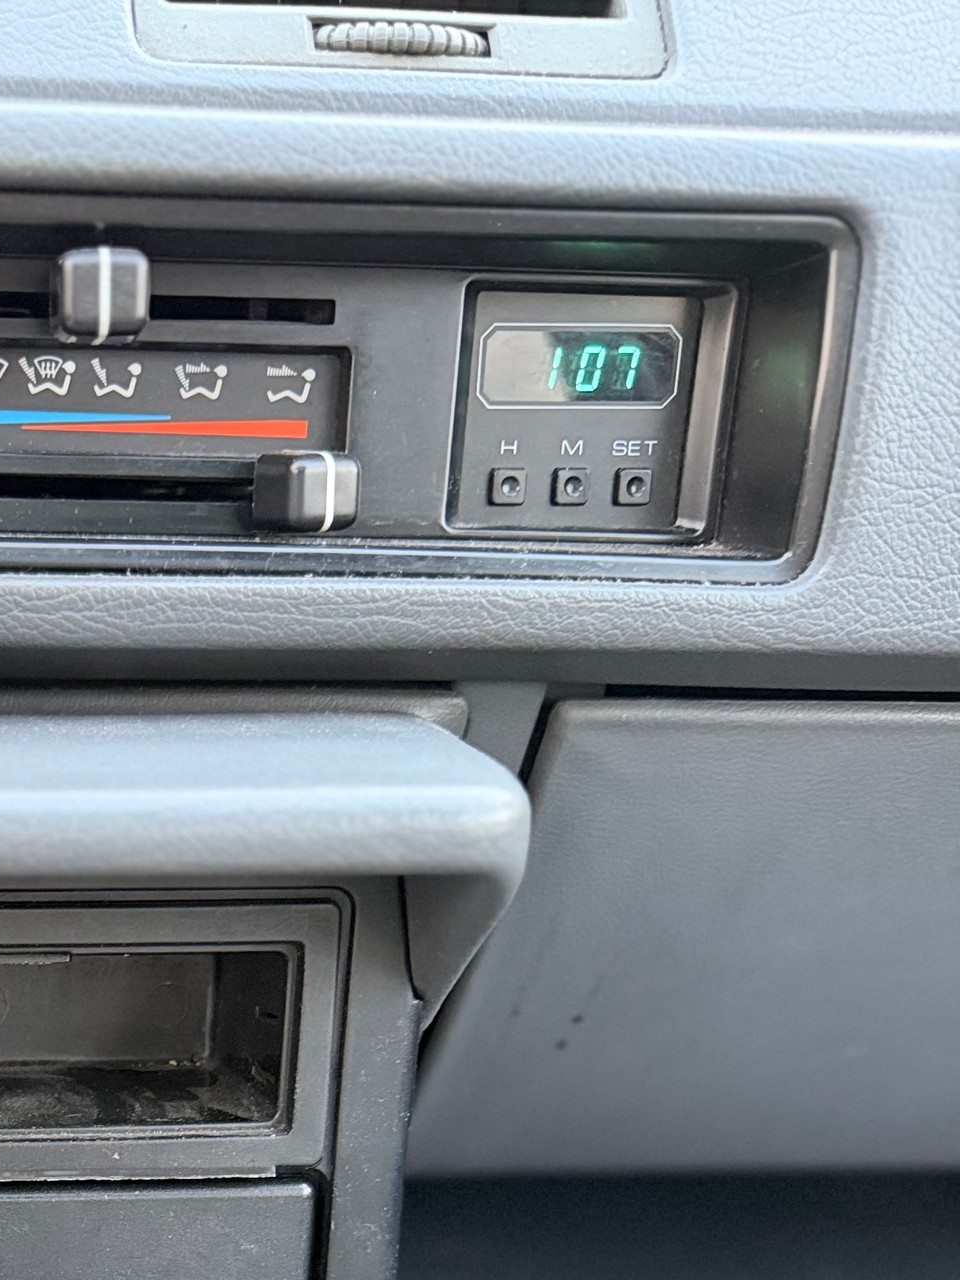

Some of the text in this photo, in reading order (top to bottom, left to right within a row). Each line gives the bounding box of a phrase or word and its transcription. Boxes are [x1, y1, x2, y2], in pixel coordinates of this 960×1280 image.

[500, 440, 518, 456] H
[560, 439, 584, 456] M
[612, 440, 658, 456] SET
